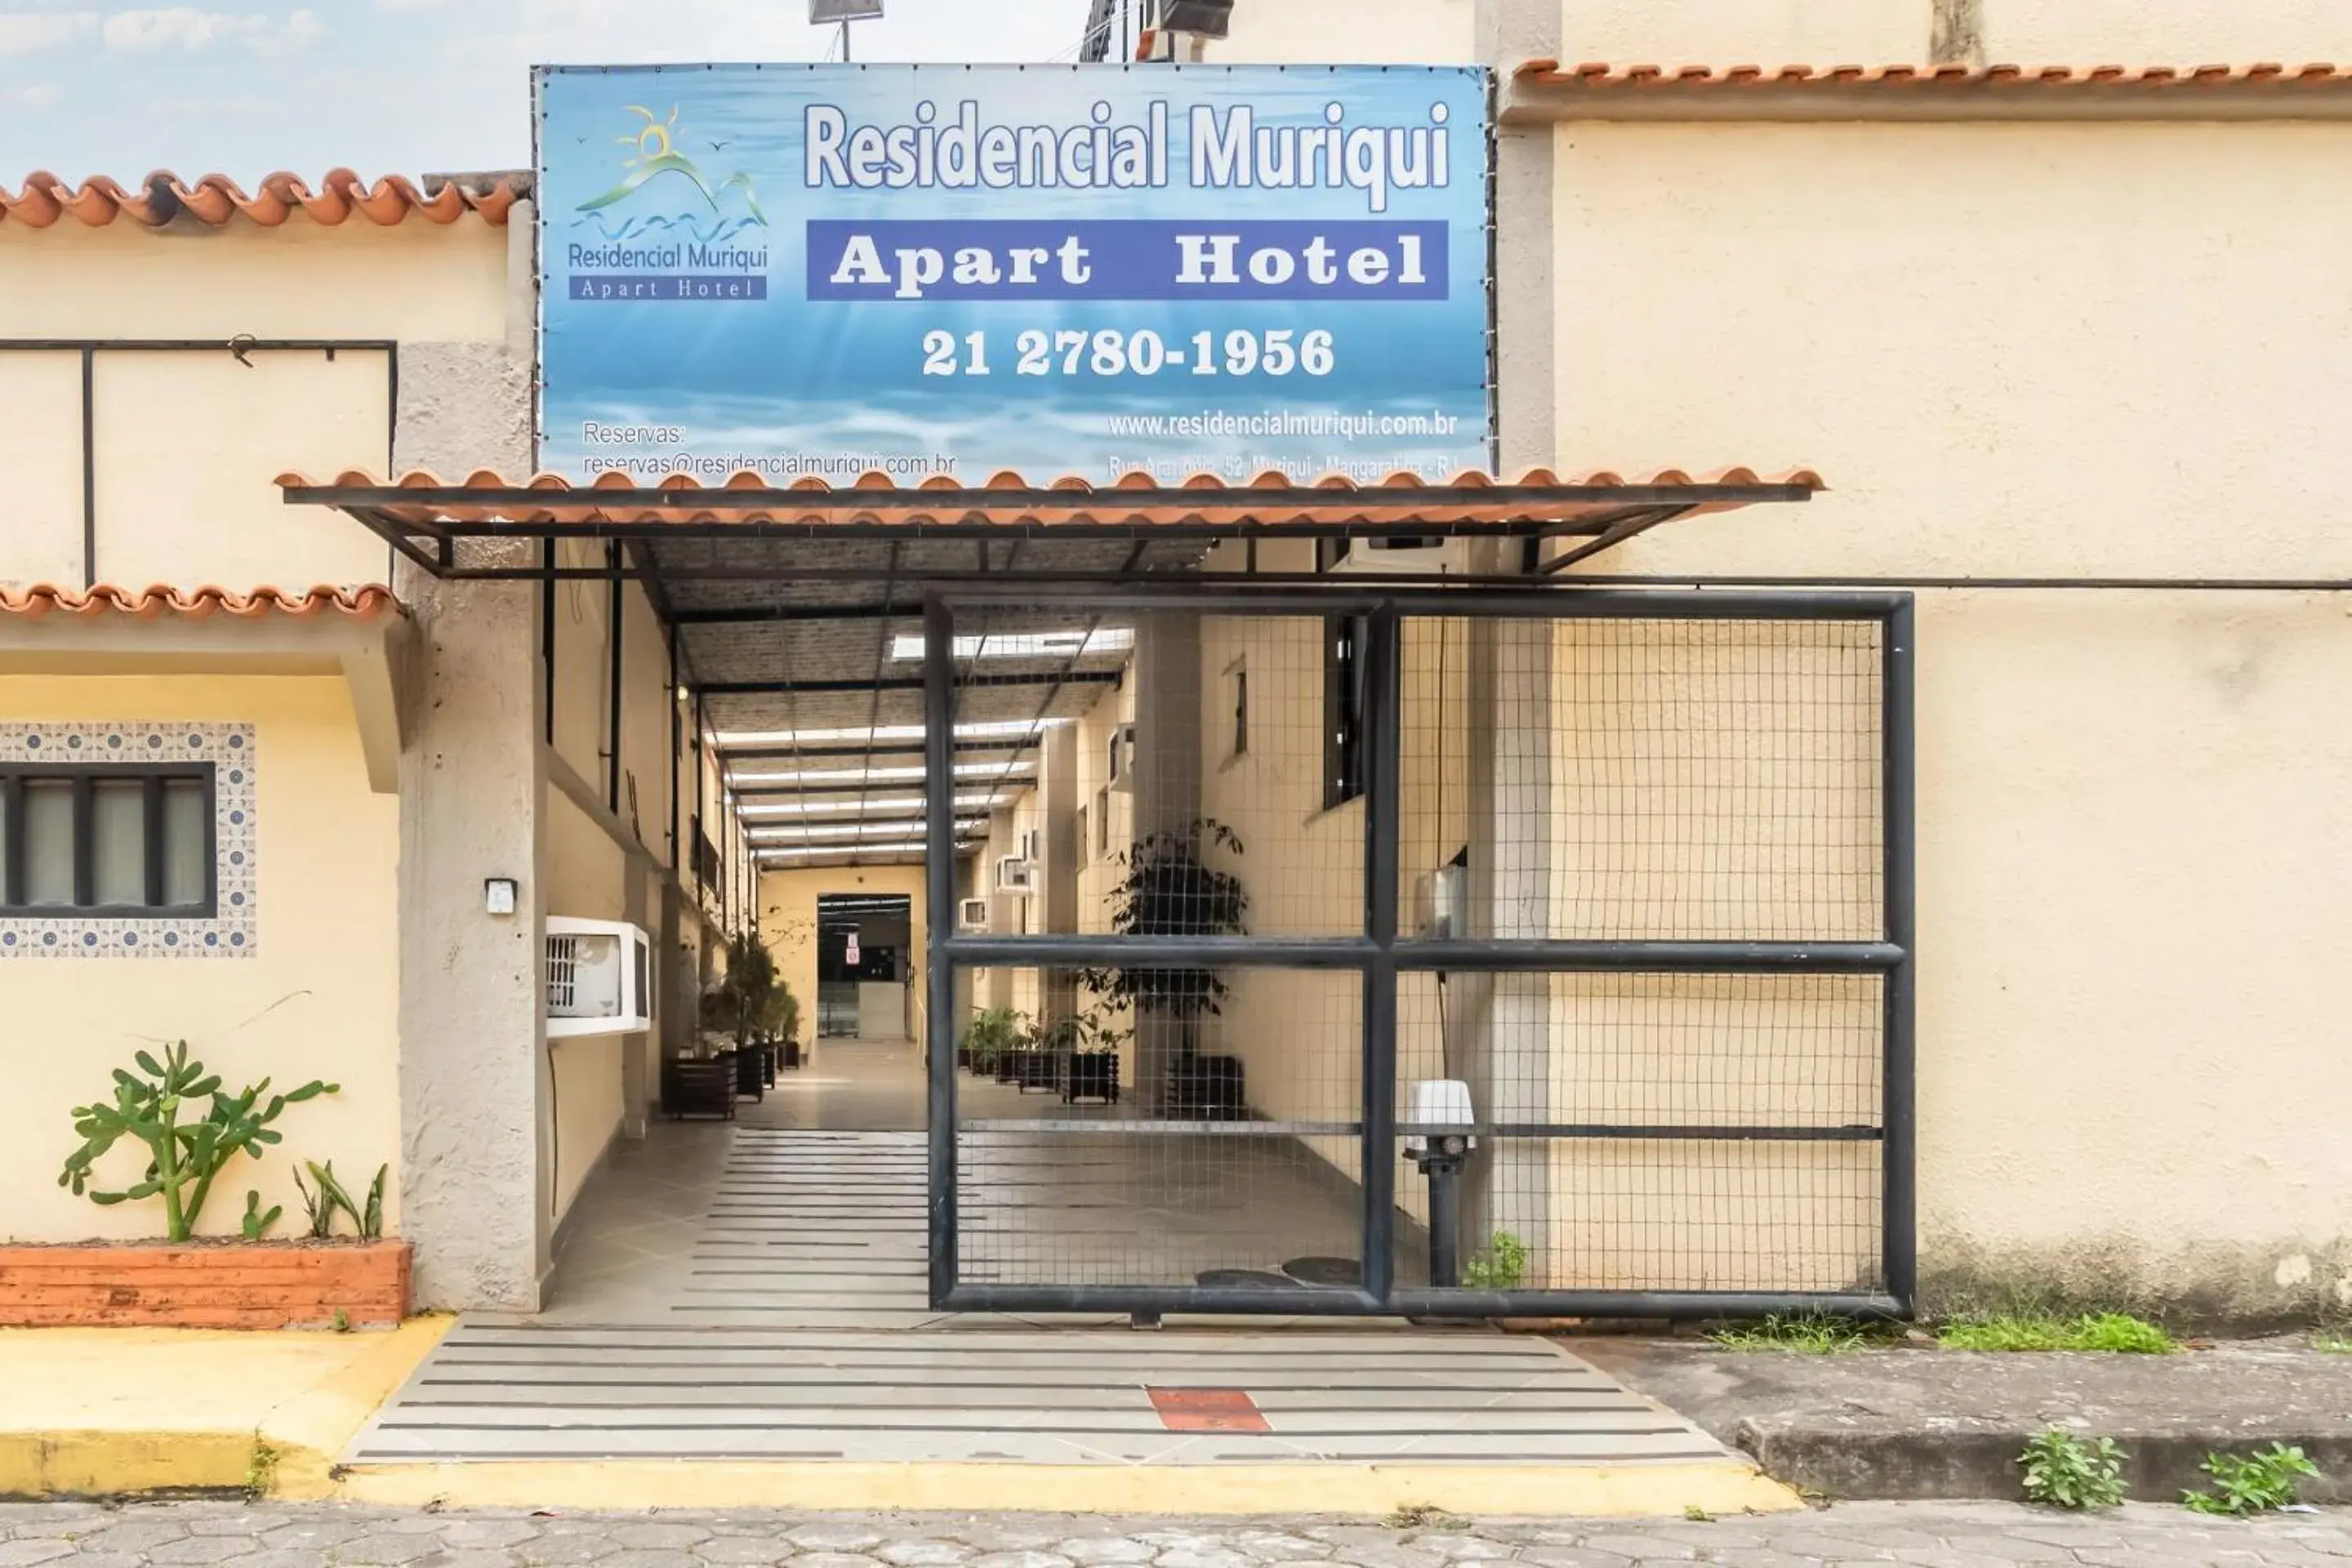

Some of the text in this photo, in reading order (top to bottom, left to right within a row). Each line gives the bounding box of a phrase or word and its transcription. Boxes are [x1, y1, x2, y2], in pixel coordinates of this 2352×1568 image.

[804, 100, 1450, 213] Residencial Muriqui
[569, 243, 768, 273] Residencial Muriqui
[830, 234, 1426, 298] Apart Hotel
[581, 278, 752, 299] Apart Hotel
[922, 329, 1334, 376] 21 2780-1956
[583, 421, 686, 444] Reservas:
[1107, 410, 1459, 440] www.residencialmuriqui.com.br
[583, 452, 956, 475] reservas@residencialmuriquicom.br
